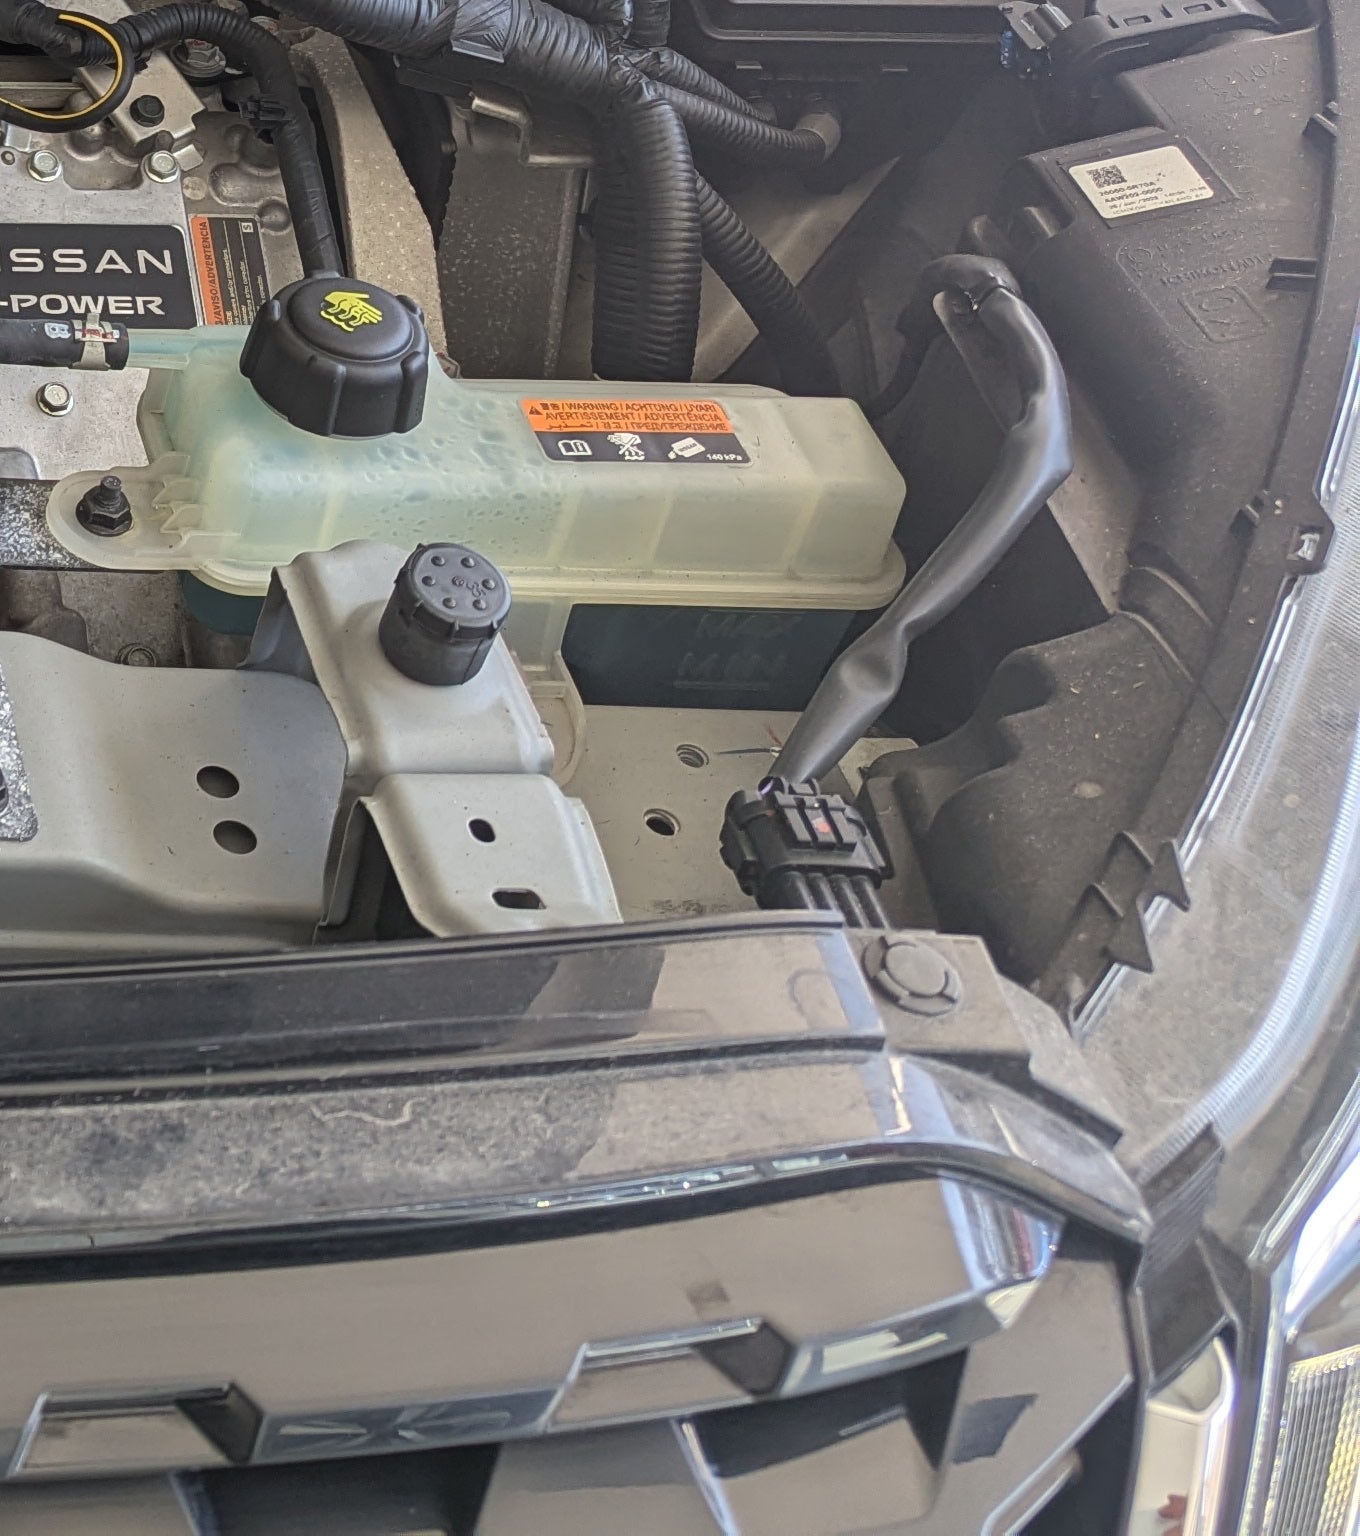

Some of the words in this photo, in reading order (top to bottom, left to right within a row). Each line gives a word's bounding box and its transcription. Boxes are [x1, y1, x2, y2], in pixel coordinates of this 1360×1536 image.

[566, 402, 619, 411] WARNING
[625, 403, 678, 412] ACHTUNG
[685, 404, 717, 413] UYARI
[545, 411, 637, 421] AVERTISSEMENT
